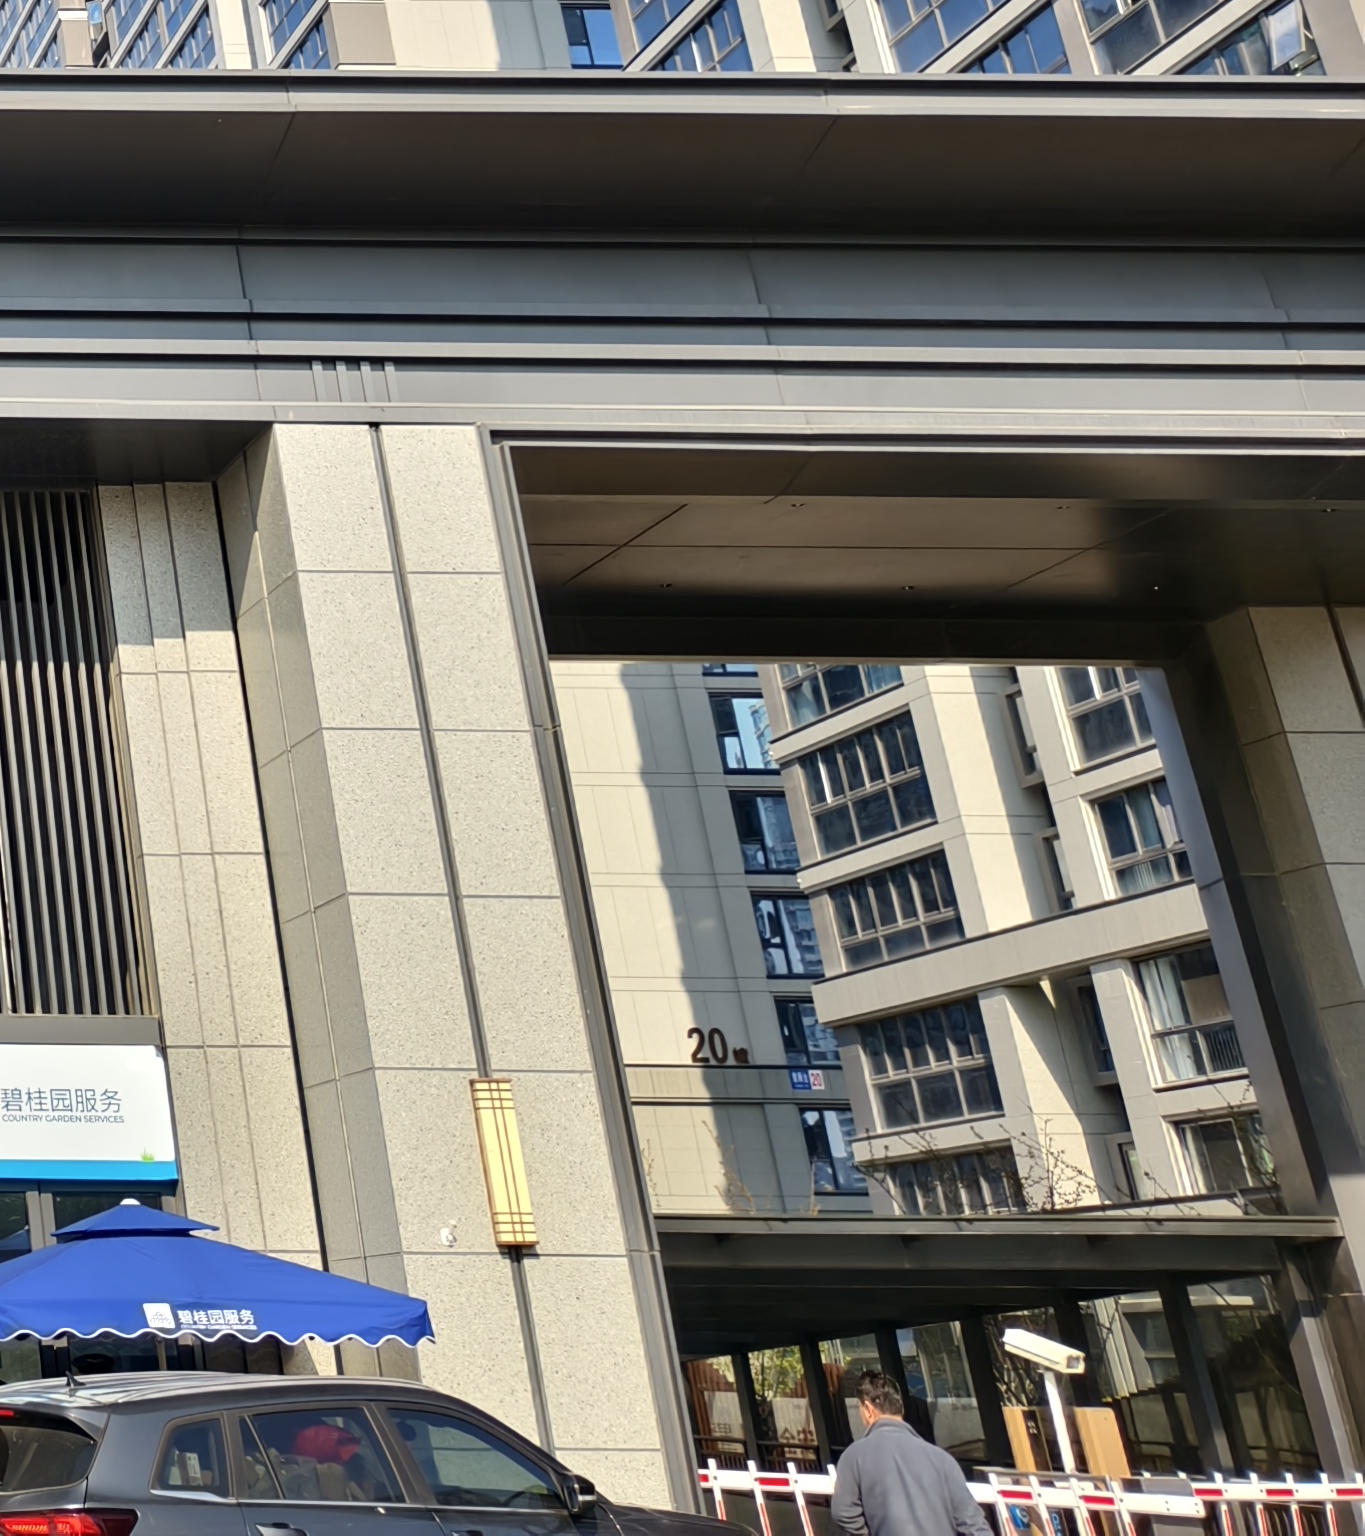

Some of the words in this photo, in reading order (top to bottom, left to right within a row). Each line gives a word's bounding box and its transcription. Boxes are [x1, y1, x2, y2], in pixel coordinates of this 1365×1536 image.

[0, 1087, 122, 1113] 碧桂园服务
[1, 1114, 43, 1123] COUNTRY
[45, 1114, 82, 1123] GARDEN
[83, 1115, 125, 1124] SERVICES
[176, 1308, 255, 1325] 碧桂园服务
